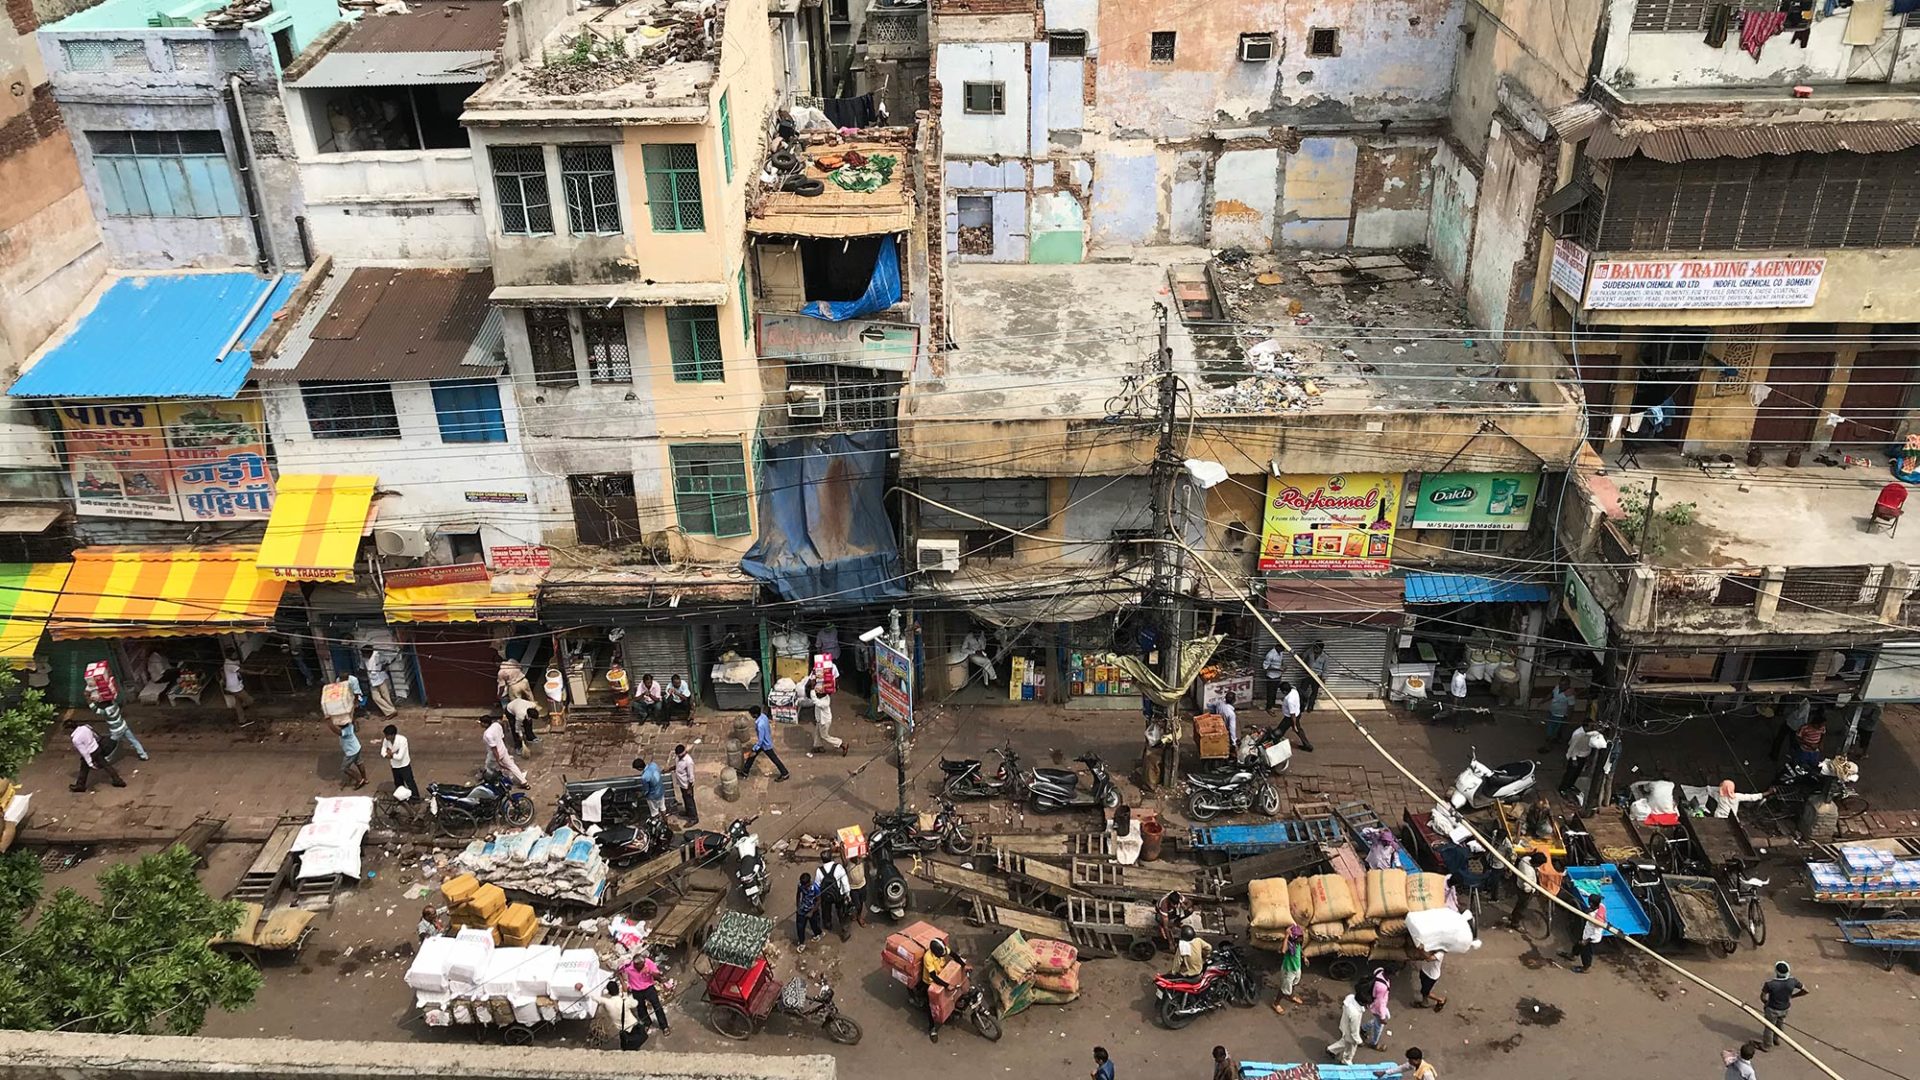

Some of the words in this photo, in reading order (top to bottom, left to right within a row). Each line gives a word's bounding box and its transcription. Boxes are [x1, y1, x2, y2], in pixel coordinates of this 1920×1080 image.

[1608, 263, 1676, 279] BANKEY
[1679, 261, 1748, 279] TRADING
[1749, 259, 1824, 277] AGENCIES
[1602, 280, 1645, 289] SUDERSHAN
[1646, 280, 1674, 289] CHEMICAL
[1675, 280, 1686, 288] IND
[1713, 279, 1737, 288] INDOFIL
[1739, 279, 1771, 287] CHEMICAL
[1773, 279, 1782, 287] CO
[1785, 278, 1813, 287] BOMBAY
[61, 402, 147, 427] पाल
[180, 452, 267, 487] जड़ी
[1273, 486, 1380, 515] Rajkamal
[1433, 488, 1472, 502] Dalda
[275, 567, 284, 577] B.
[285, 567, 296, 578] M.
[297, 567, 337, 578] TRADERS
